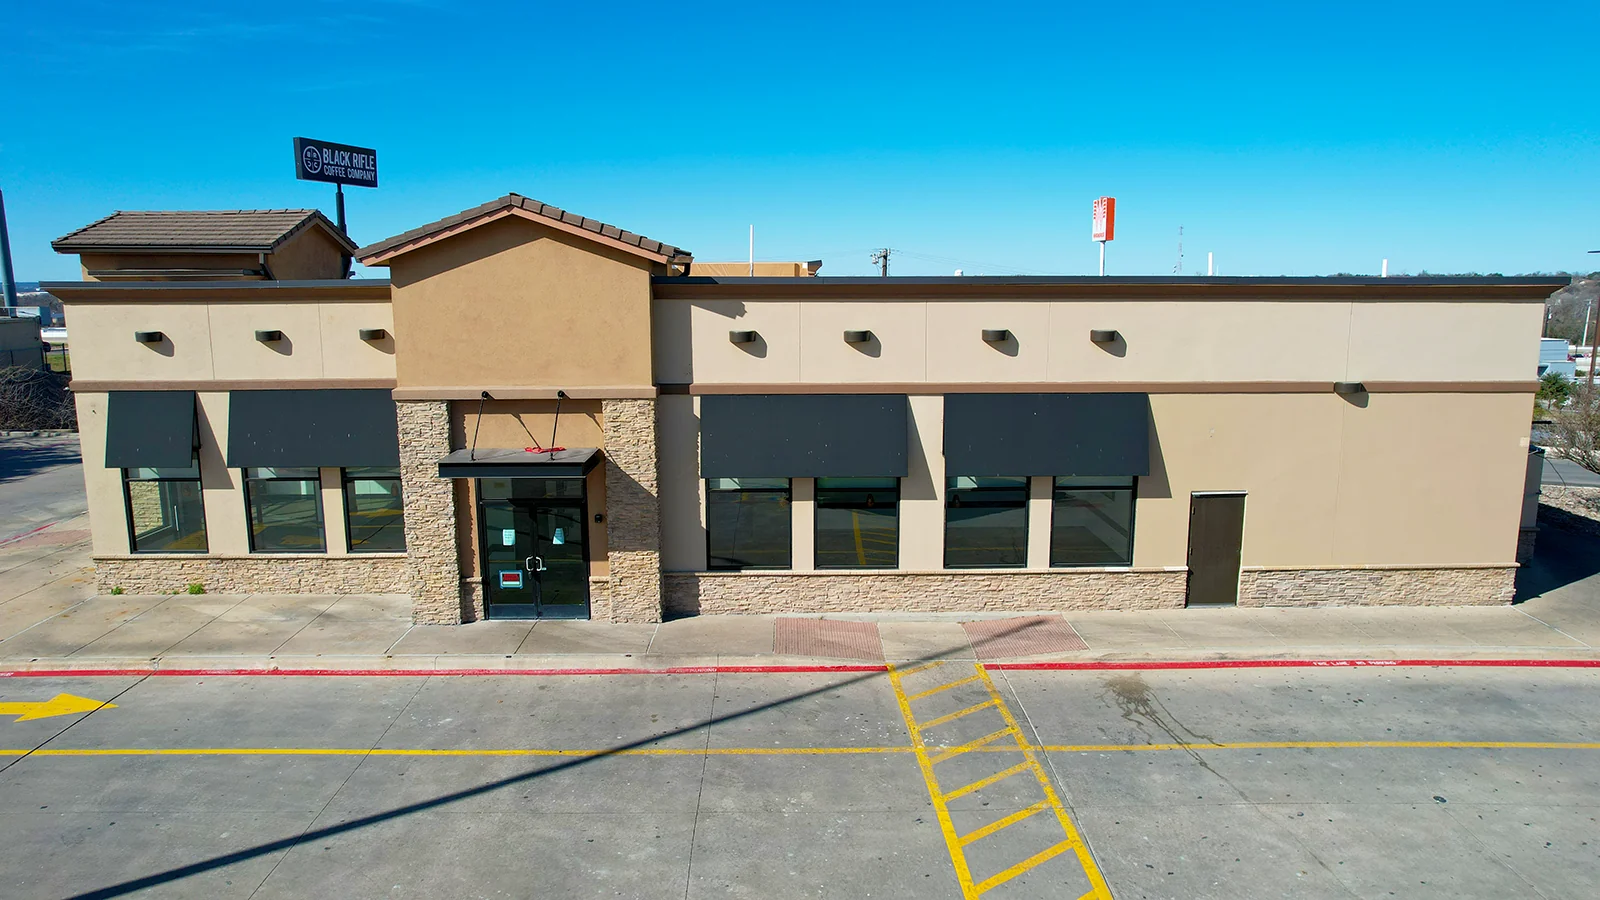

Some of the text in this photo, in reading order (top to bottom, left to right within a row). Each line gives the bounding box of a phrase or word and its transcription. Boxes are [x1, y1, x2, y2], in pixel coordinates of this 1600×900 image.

[323, 148, 375, 170] BLACK RIFLE
[323, 165, 375, 181] COFFEE COMPANY
